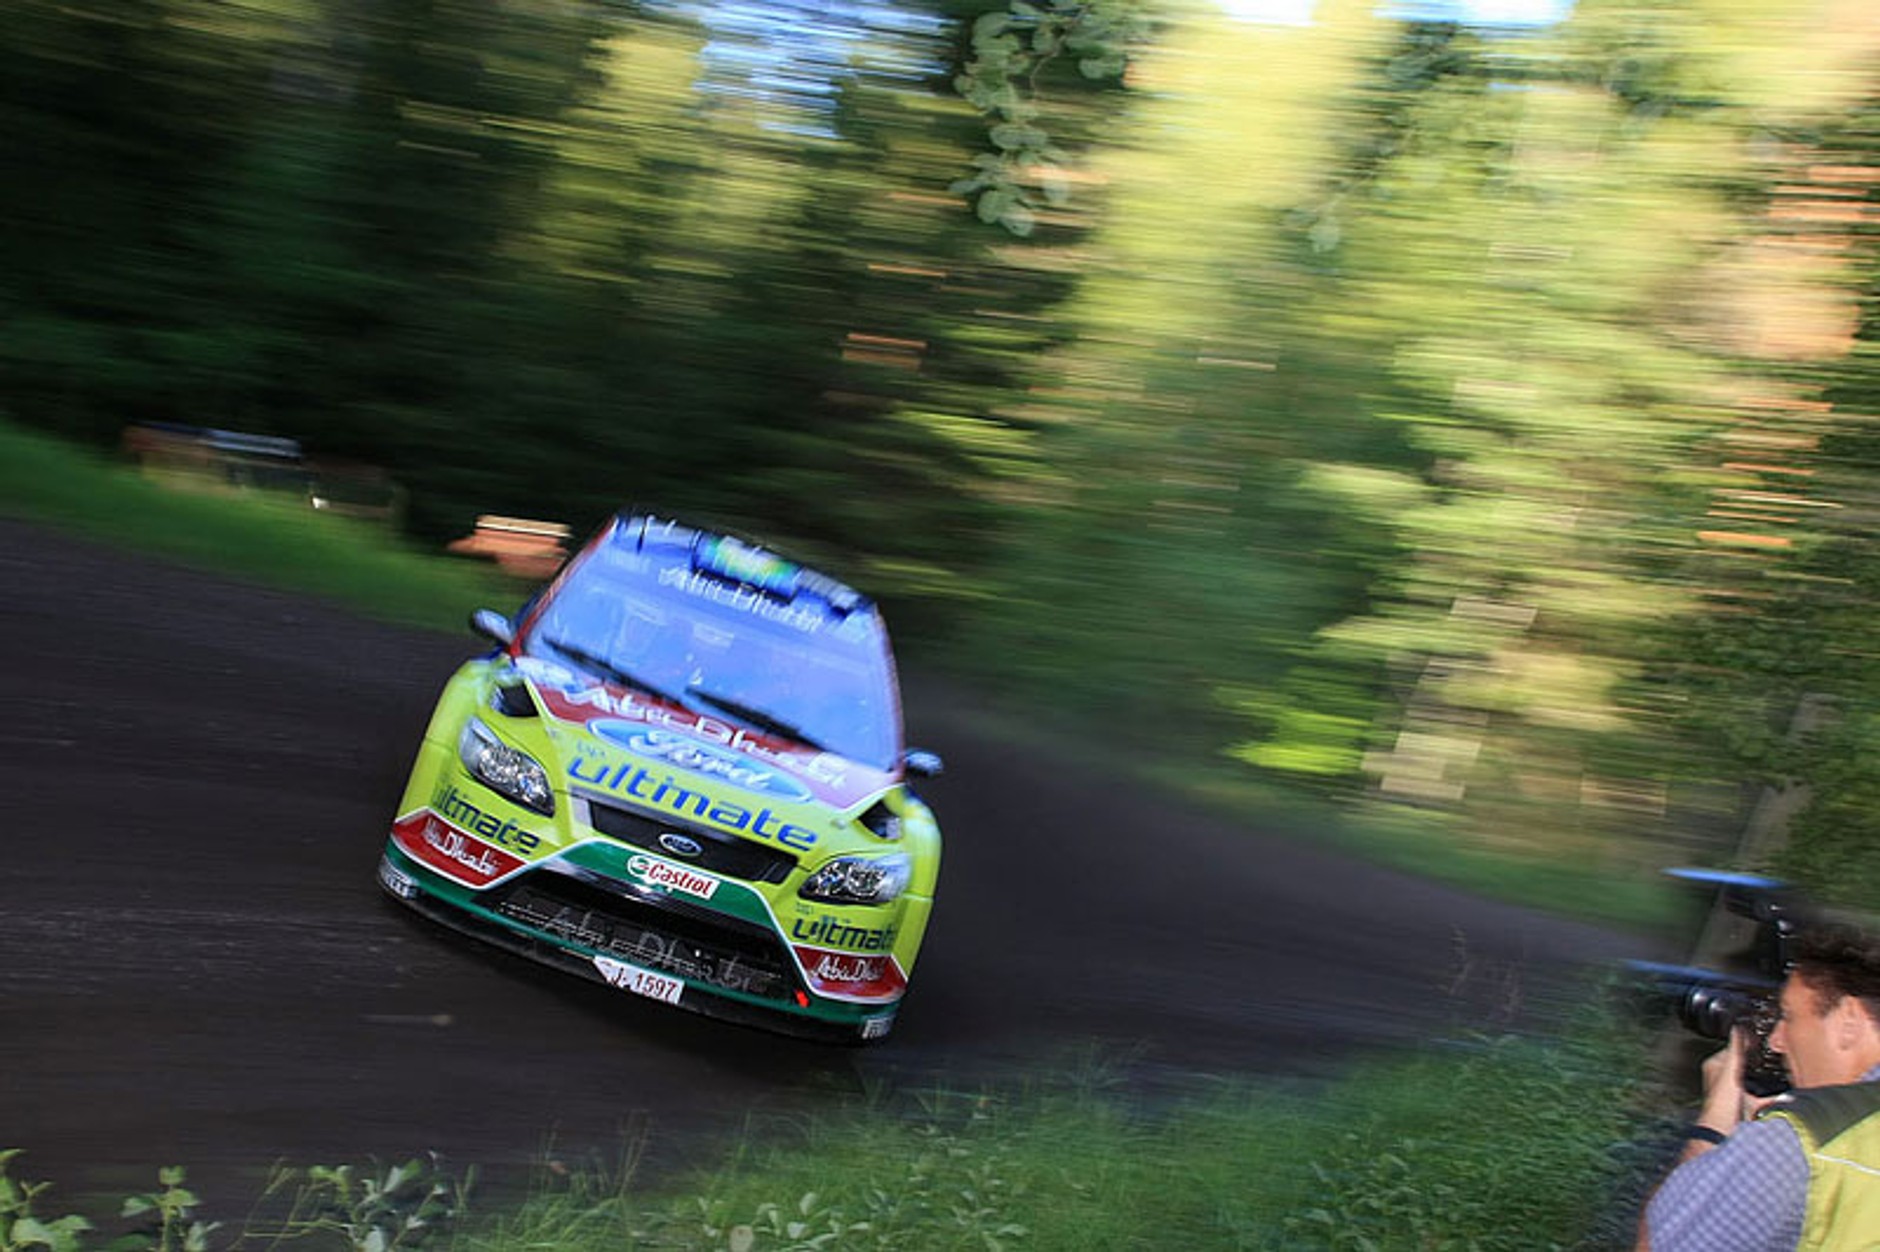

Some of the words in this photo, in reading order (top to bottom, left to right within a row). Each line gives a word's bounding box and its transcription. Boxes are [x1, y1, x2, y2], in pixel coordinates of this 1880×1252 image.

[628, 730, 774, 792] Ford
[566, 755, 819, 852] ultimate
[648, 861, 714, 896] Castrol
